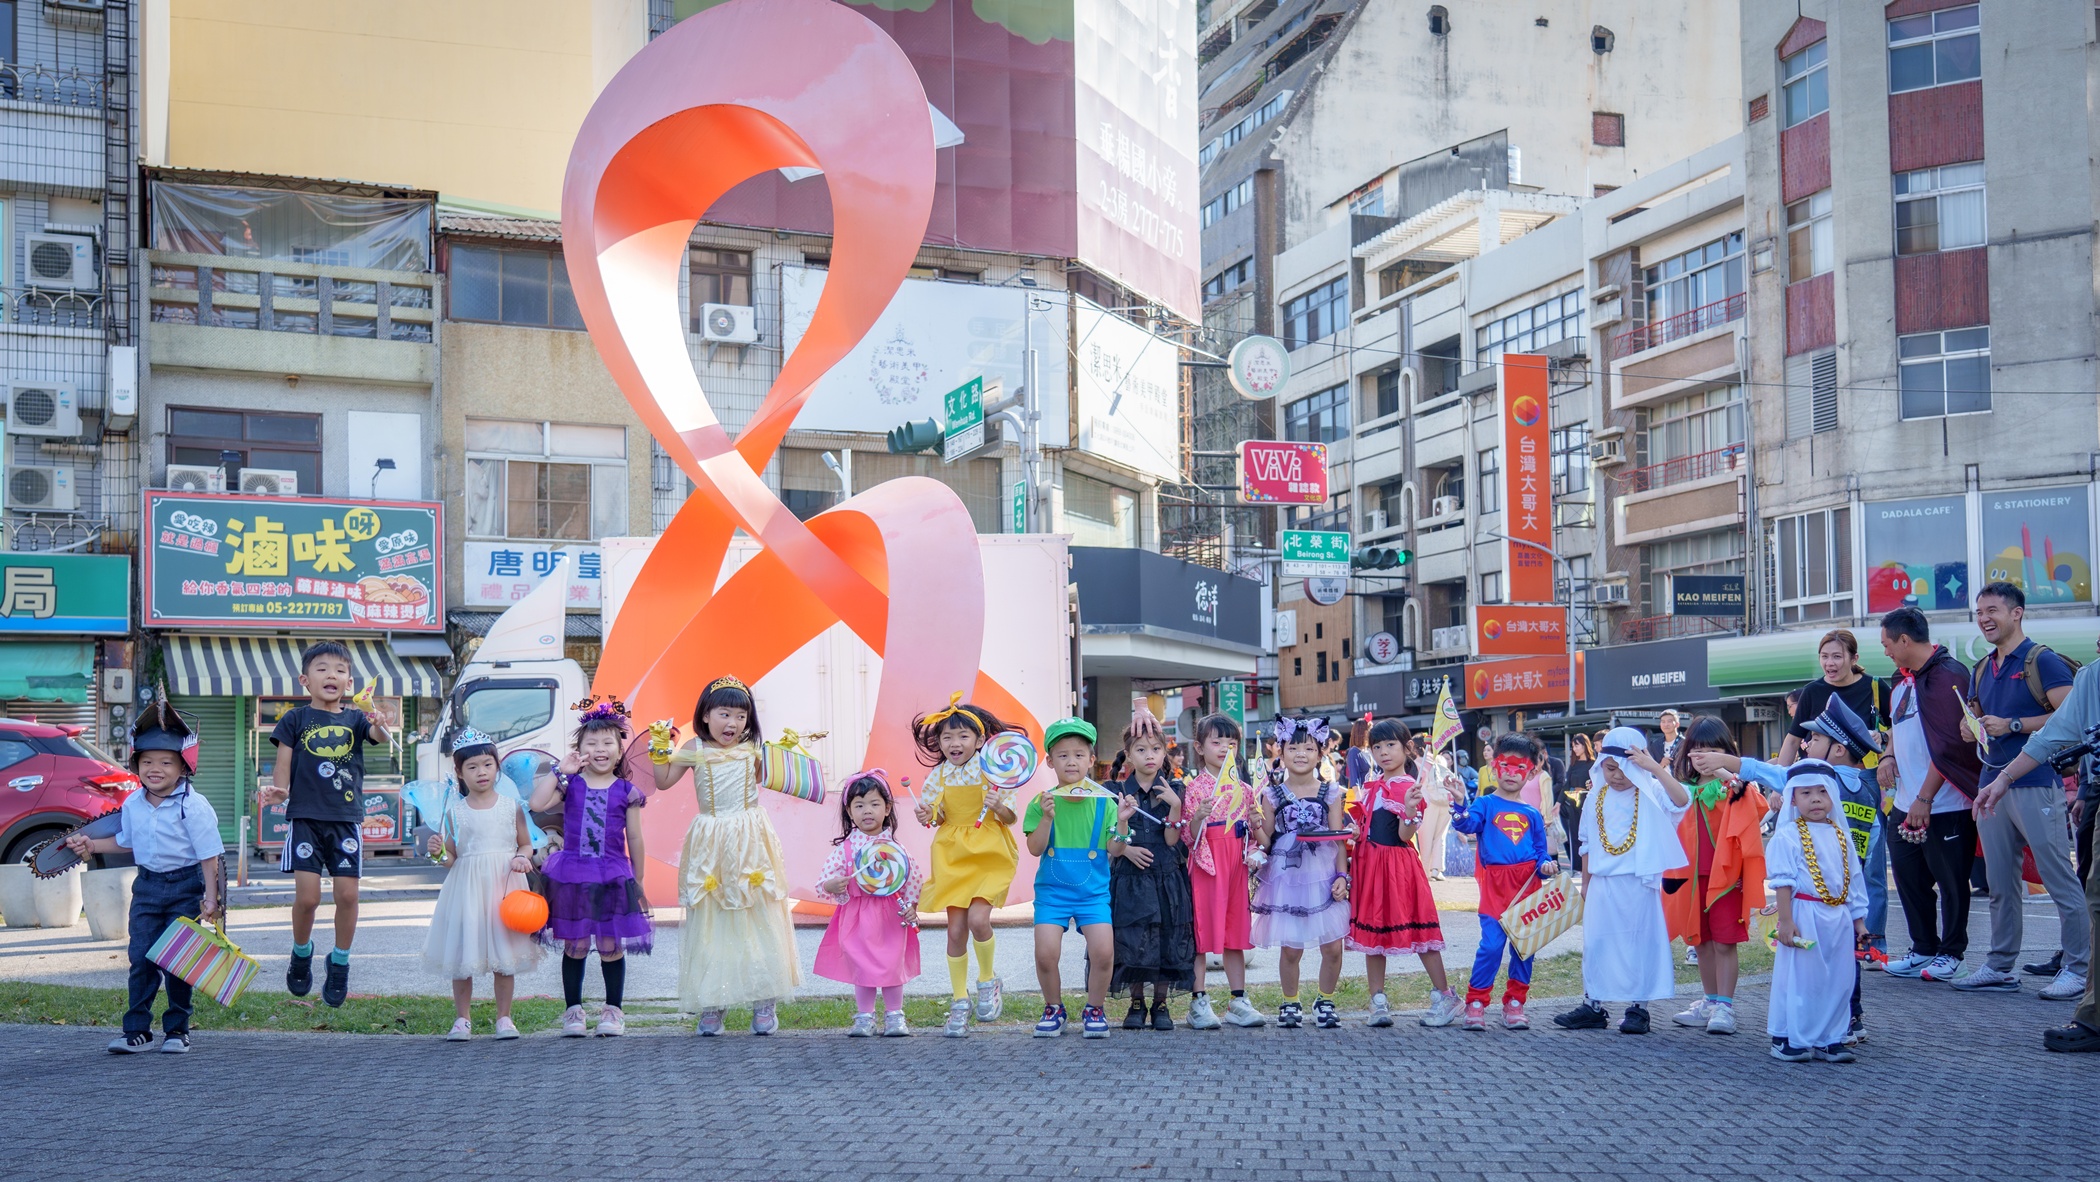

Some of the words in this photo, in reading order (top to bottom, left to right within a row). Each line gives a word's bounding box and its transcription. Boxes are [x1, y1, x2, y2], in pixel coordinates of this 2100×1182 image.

[1131, 201, 1184, 258] 2777-775
[948, 383, 979, 418] 文化路
[1250, 449, 1302, 481] ViVi
[1519, 435, 1538, 531] 台灣大哥大
[1993, 502, 2002, 510] &
[2004, 497, 2072, 510] STATIONERY
[1881, 509, 1922, 519] DADALA
[1289, 534, 1343, 549] 北榮街
[1297, 550, 1324, 560] Beirong
[1326, 551, 1336, 559] St.
[0, 566, 57, 619] 局
[1677, 593, 1700, 602] KAO
[1702, 593, 1742, 602] MEIFEN
[266, 602, 344, 616] 05-2277787
[1506, 620, 1560, 633] 台灣大哥大
[1493, 671, 1543, 692] 台灣大哥大
[1631, 674, 1650, 687] KAO
[1652, 671, 1686, 685] MEIFEN
[1520, 887, 1565, 926] meiji
